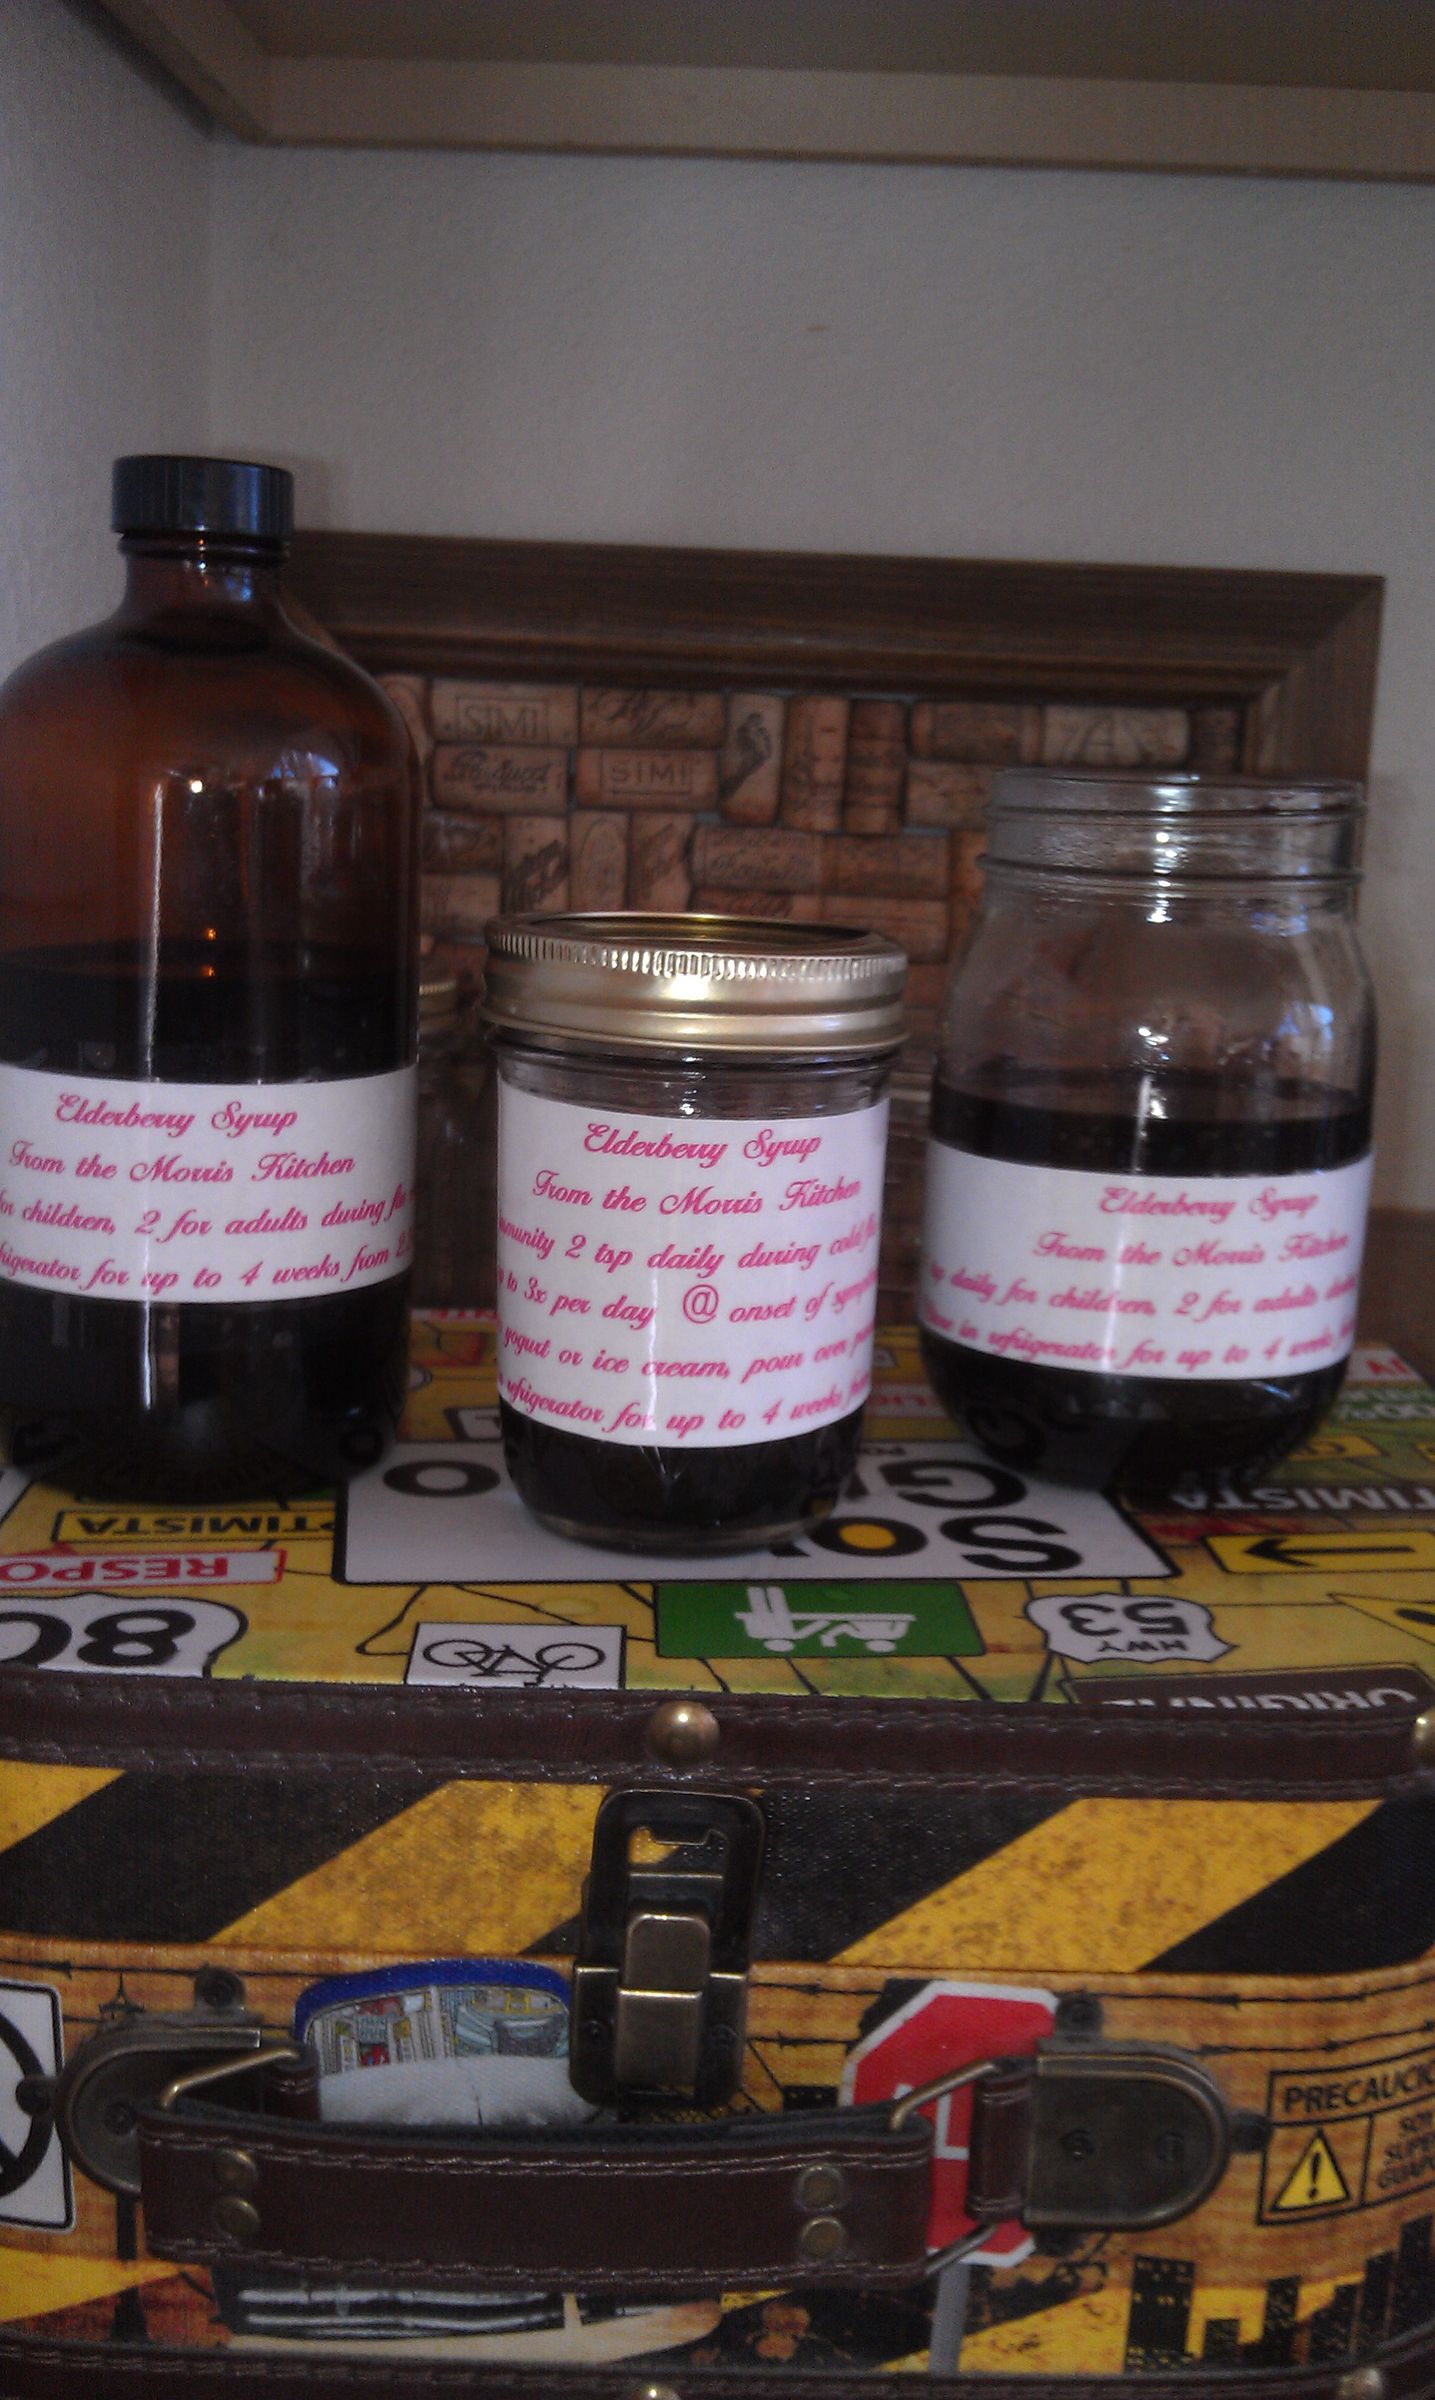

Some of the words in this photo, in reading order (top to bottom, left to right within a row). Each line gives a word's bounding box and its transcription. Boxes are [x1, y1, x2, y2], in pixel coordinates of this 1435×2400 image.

[609, 762, 689, 784] SIMI
[56, 1095, 196, 1138] Elderberry
[210, 1101, 297, 1137] Syrup
[11, 1142, 64, 1173] From
[75, 1153, 117, 1180] the
[129, 1156, 233, 1183] Morris
[251, 1152, 354, 1181] Kitchen
[583, 1123, 728, 1168] Elderberry
[742, 1128, 821, 1167] Syrup
[533, 1169, 591, 1206] From
[601, 1185, 647, 1213] the
[658, 1185, 763, 1216] Morris
[779, 1177, 861, 1212] Kitchen
[1100, 1188, 1235, 1221] Elderberry
[1250, 1188, 1317, 1220] Syrup
[24, 1200, 116, 1234] children,
[136, 1210, 160, 1234] 2
[155, 1210, 211, 1242] for
[225, 1206, 308, 1235] adults
[321, 1200, 387, 1227] during
[565, 1234, 587, 1259] 2
[594, 1243, 633, 1274] tsp
[646, 1244, 725, 1279] daily
[737, 1242, 820, 1270] during
[1034, 1232, 1105, 1262] From
[1120, 1243, 1160, 1264] the
[1173, 1240, 1264, 1266] Morris
[78, 1259, 128, 1289] for
[140, 1272, 179, 1295] up
[193, 1266, 221, 1288] to
[241, 1262, 262, 1286] 4
[272, 1254, 340, 1284] weeks
[339, 1246, 390, 1282] from
[507, 1273, 517, 1292] to
[524, 1278, 546, 1303] 3x
[550, 1294, 589, 1316] per
[601, 1295, 656, 1331] day
[681, 1283, 720, 1325] @
[728, 1296, 797, 1323] onset
[805, 1283, 835, 1321] of
[1001, 1280, 1036, 1304] for
[1049, 1287, 1155, 1315] children,
[1174, 1293, 1200, 1316] 2
[1193, 1291, 1241, 1322] for
[504, 1326, 551, 1358] yogurt
[559, 1350, 582, 1366] or
[592, 1349, 629, 1373] ice
[641, 1360, 730, 1378] cream,
[741, 1353, 804, 1383] pour
[988, 1327, 1115, 1360] refrigerator
[1121, 1341, 1164, 1367] for
[1177, 1346, 1211, 1370] up
[507, 1379, 603, 1423] refrigerator
[601, 1402, 653, 1432] for
[666, 1412, 704, 1439] up
[718, 1407, 745, 1430] to
[763, 1401, 780, 1424] 4
[0, 1557, 229, 1582] RESPO
[1059, 1602, 1190, 1638] 53
[1096, 1638, 1187, 1653] HWY
